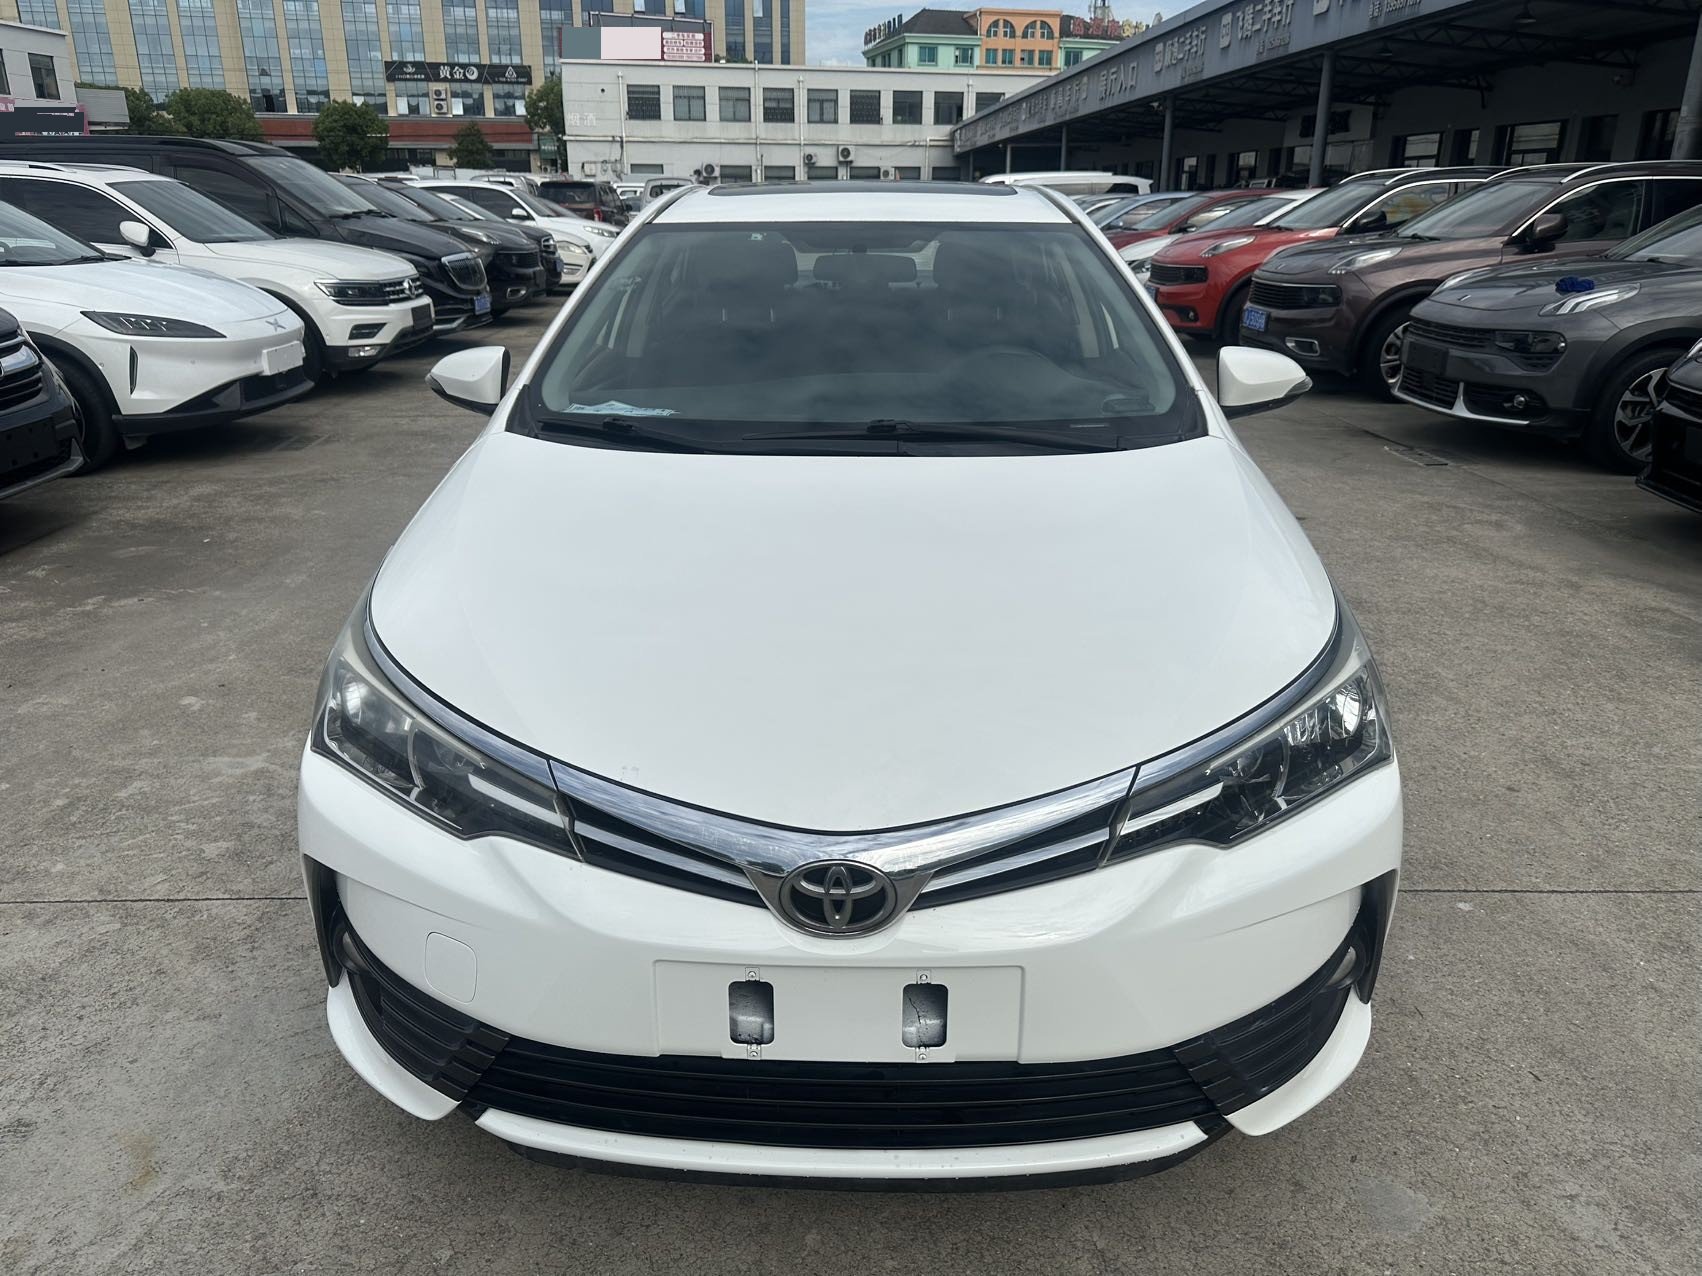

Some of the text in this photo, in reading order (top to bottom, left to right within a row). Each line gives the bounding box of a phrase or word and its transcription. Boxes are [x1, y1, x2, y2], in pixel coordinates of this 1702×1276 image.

[439, 65, 464, 80] 黄金
[1099, 61, 1138, 101] 展厅入口
